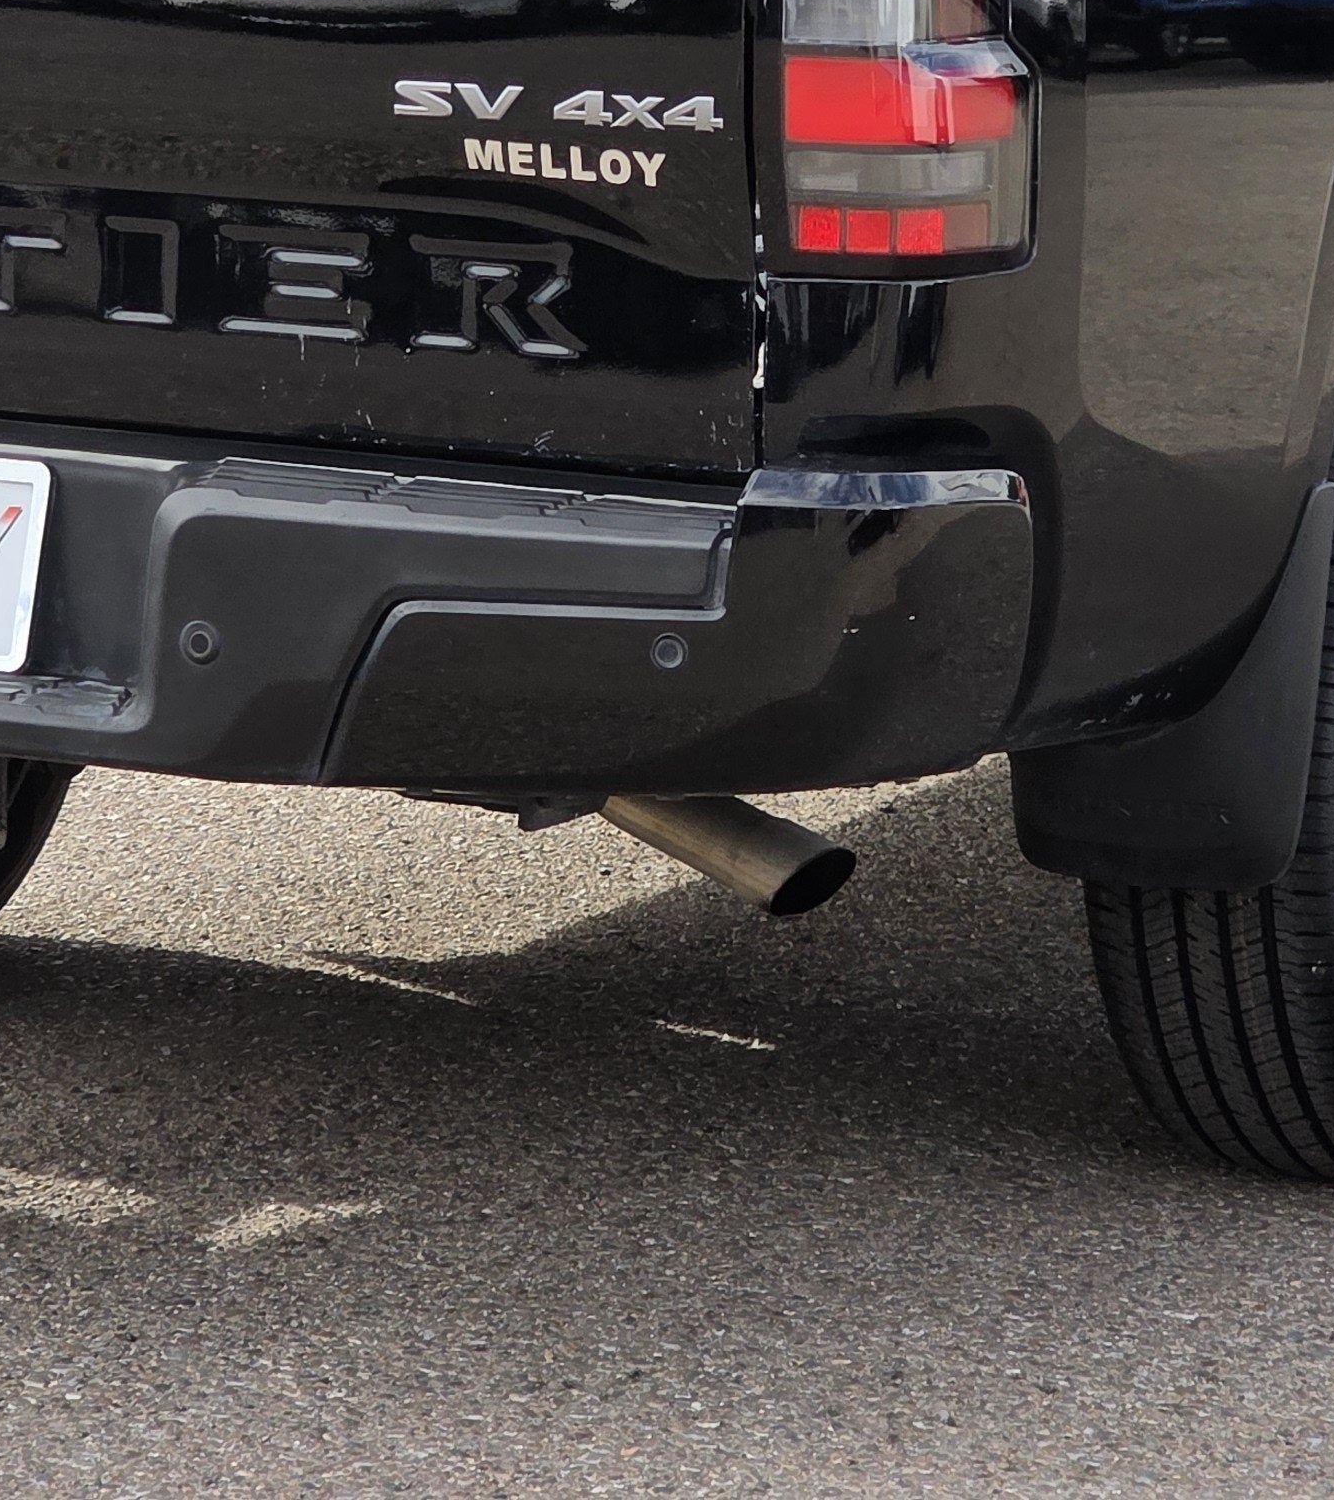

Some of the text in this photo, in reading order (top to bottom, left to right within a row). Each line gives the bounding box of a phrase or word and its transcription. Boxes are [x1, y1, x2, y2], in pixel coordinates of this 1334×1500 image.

[394, 80, 724, 132] SV 4x4
[463, 137, 666, 188] MELLOY
